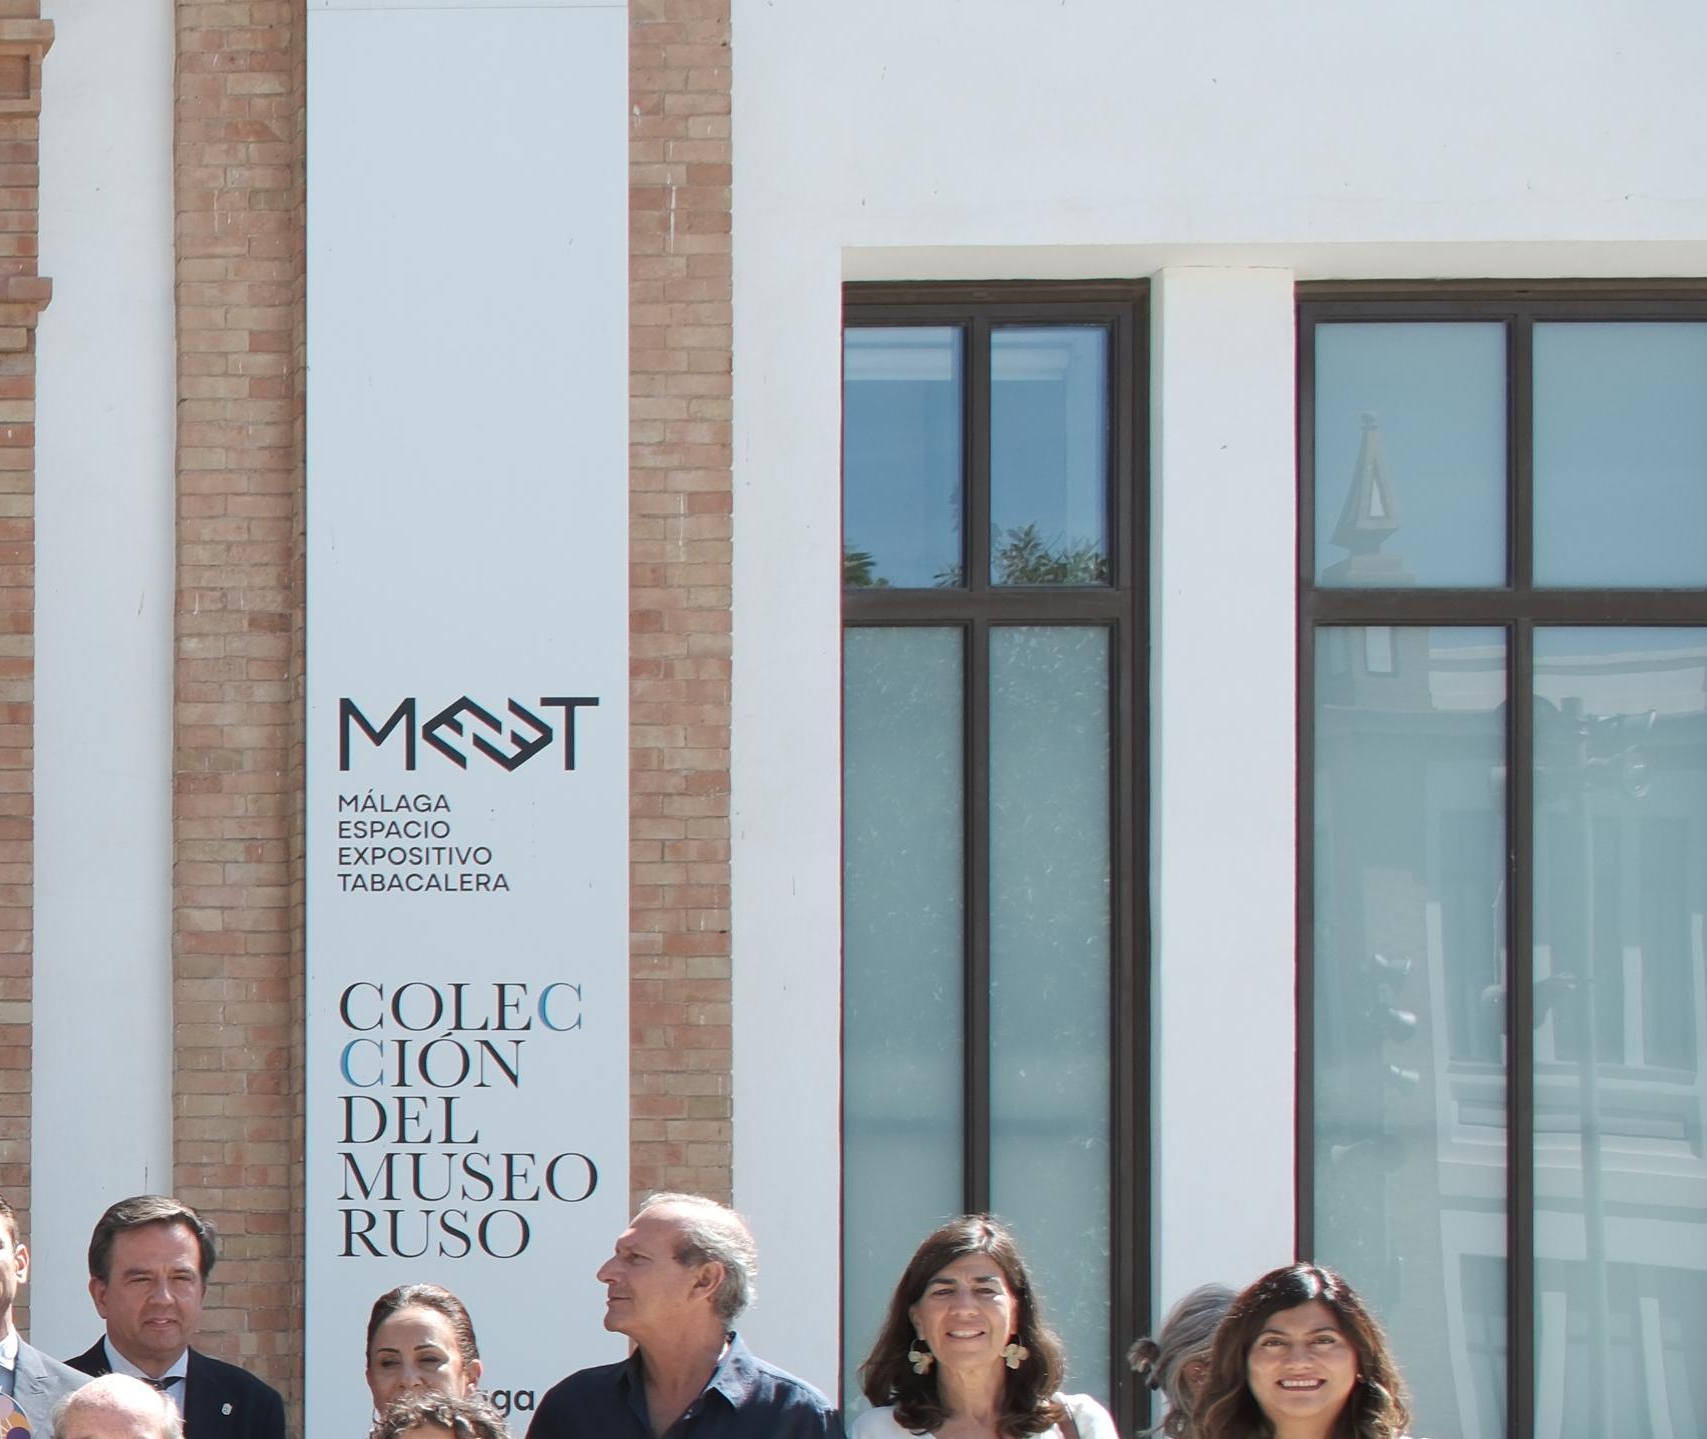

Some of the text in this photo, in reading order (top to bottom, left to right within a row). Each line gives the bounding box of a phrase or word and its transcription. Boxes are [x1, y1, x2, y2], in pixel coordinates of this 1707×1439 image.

[338, 788, 452, 813] MÁLAGA
[338, 820, 451, 839] ESPACIO
[337, 846, 493, 866] EXPOSITIVO
[337, 873, 510, 892] TABACALERA
[339, 982, 583, 1032] COLEC
[339, 1031, 525, 1088] CIÓN
[337, 1096, 479, 1145] DEL
[337, 1153, 599, 1202] MUSEO
[337, 1209, 531, 1259] RUSO
